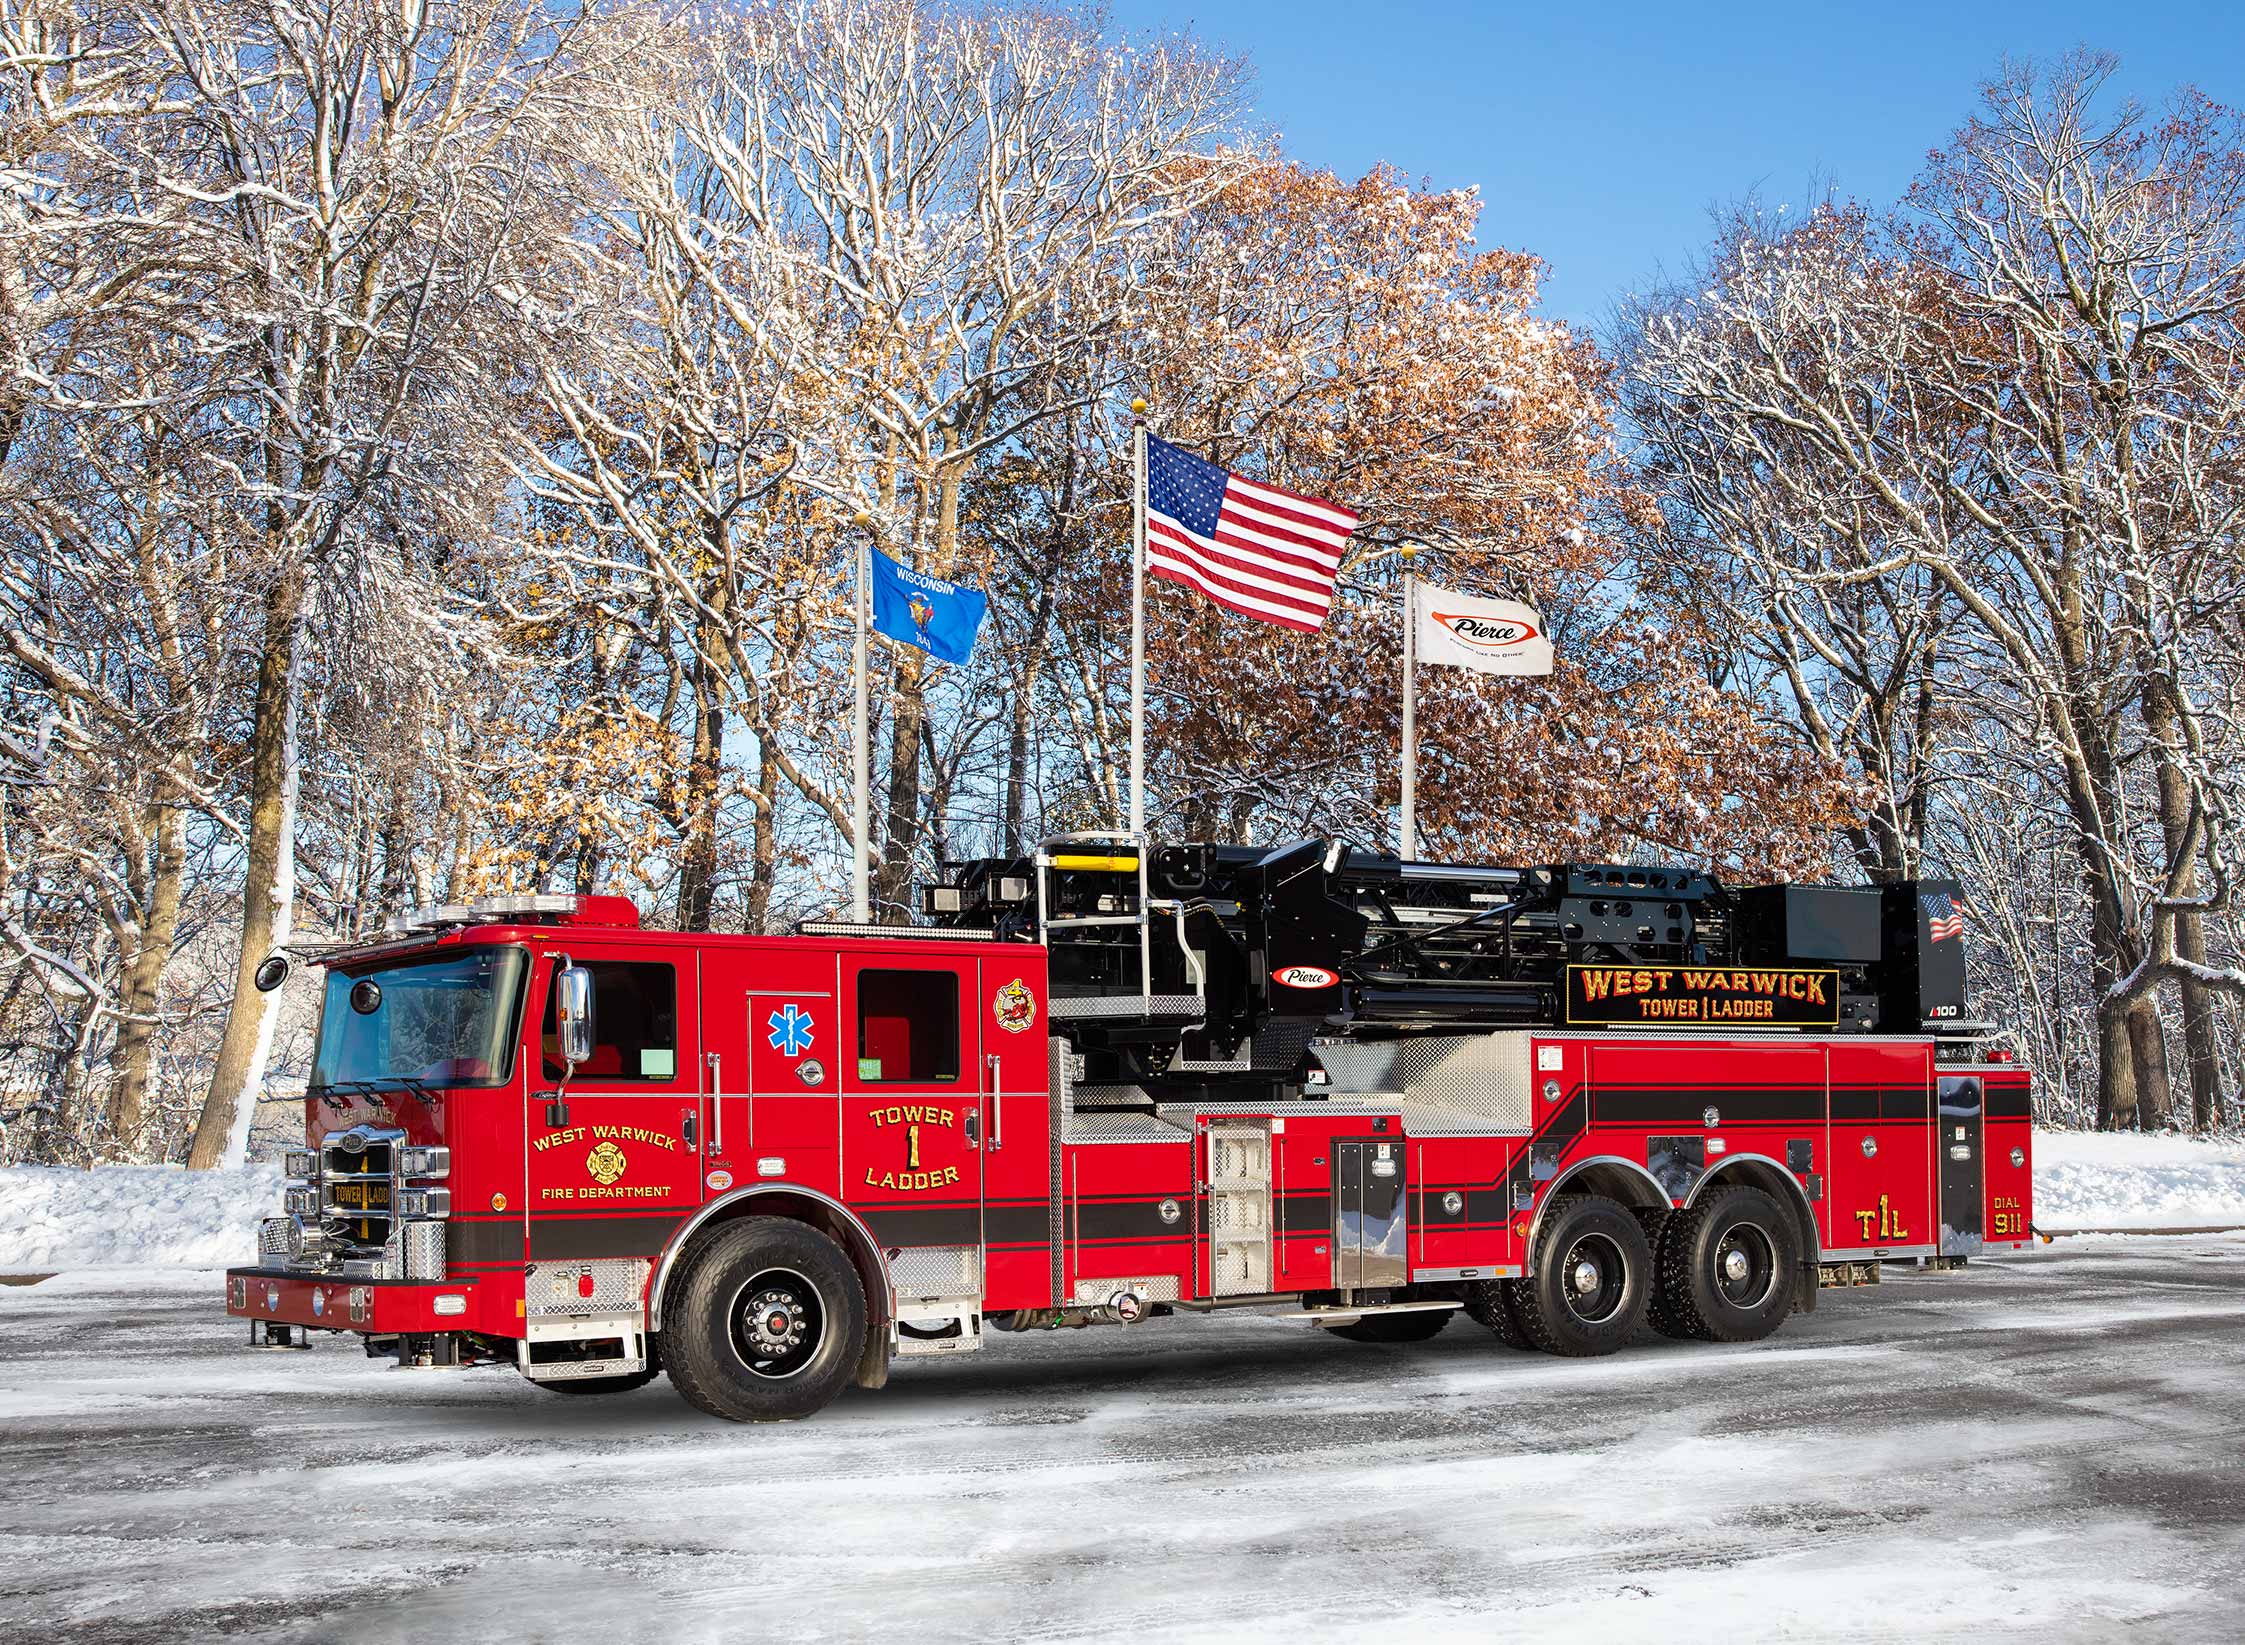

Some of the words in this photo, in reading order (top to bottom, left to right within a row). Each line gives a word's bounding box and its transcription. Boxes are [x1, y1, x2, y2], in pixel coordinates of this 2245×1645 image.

[896, 567, 955, 595] WISCONSIN
[1454, 618, 1515, 639] Pierce
[1287, 969, 1324, 983] Pierce
[1581, 970, 1673, 1002] WEST
[1682, 971, 1827, 1005] WARWICK
[1639, 999, 1698, 1017] TOWER
[1711, 999, 1774, 1018] LADDER
[868, 1105, 954, 1128] TOWER
[533, 1127, 586, 1152] WEST
[592, 1125, 677, 1151] WARWICK
[907, 1125, 920, 1169] 1
[865, 1166, 960, 1190] LADDER
[335, 1186, 361, 1203] TOWER
[368, 1186, 389, 1203] LADD
[541, 1188, 574, 1199] FIRE
[579, 1186, 671, 1198] DEPARTMENT
[1994, 1197, 2021, 1209] DIAL
[1994, 1212, 2021, 1234] 911
